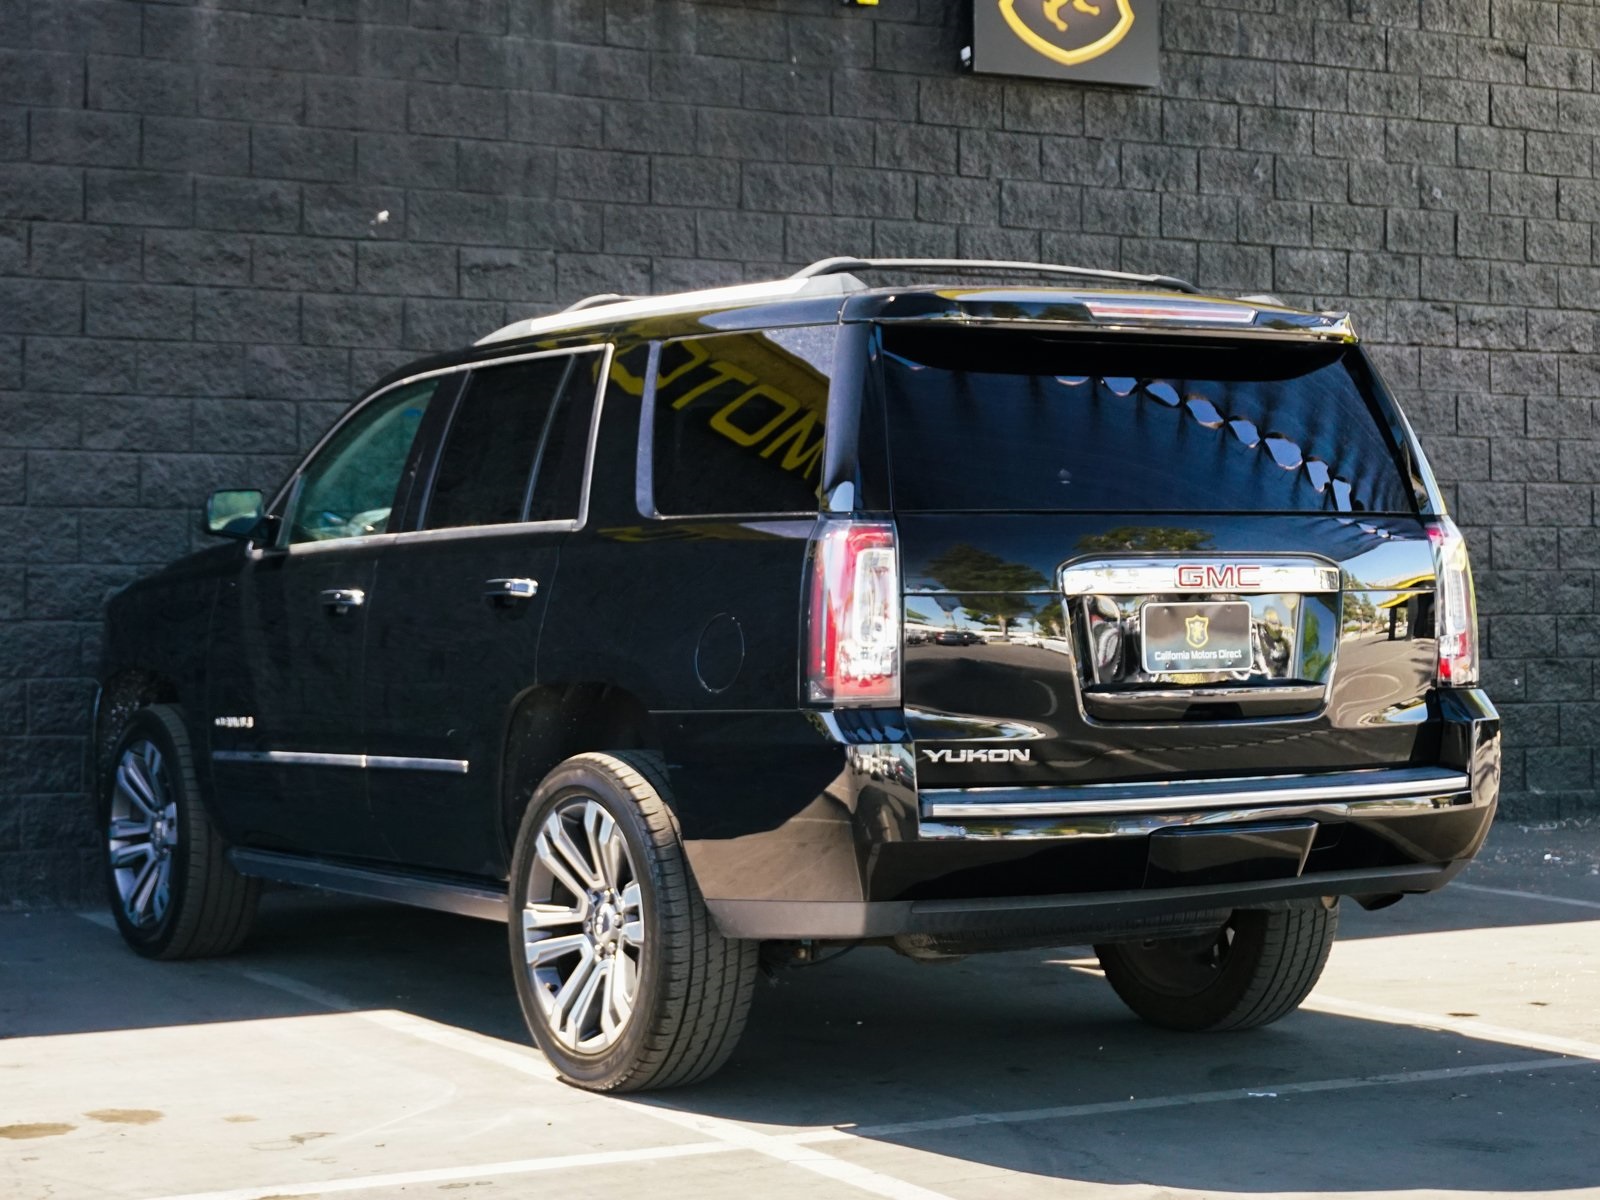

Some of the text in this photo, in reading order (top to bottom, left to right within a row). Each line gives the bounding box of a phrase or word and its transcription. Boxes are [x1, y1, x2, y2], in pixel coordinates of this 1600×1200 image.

[1177, 565, 1261, 588] GMC
[1154, 648, 1243, 661] California Motors Direct
[921, 748, 1031, 763] YUKON
